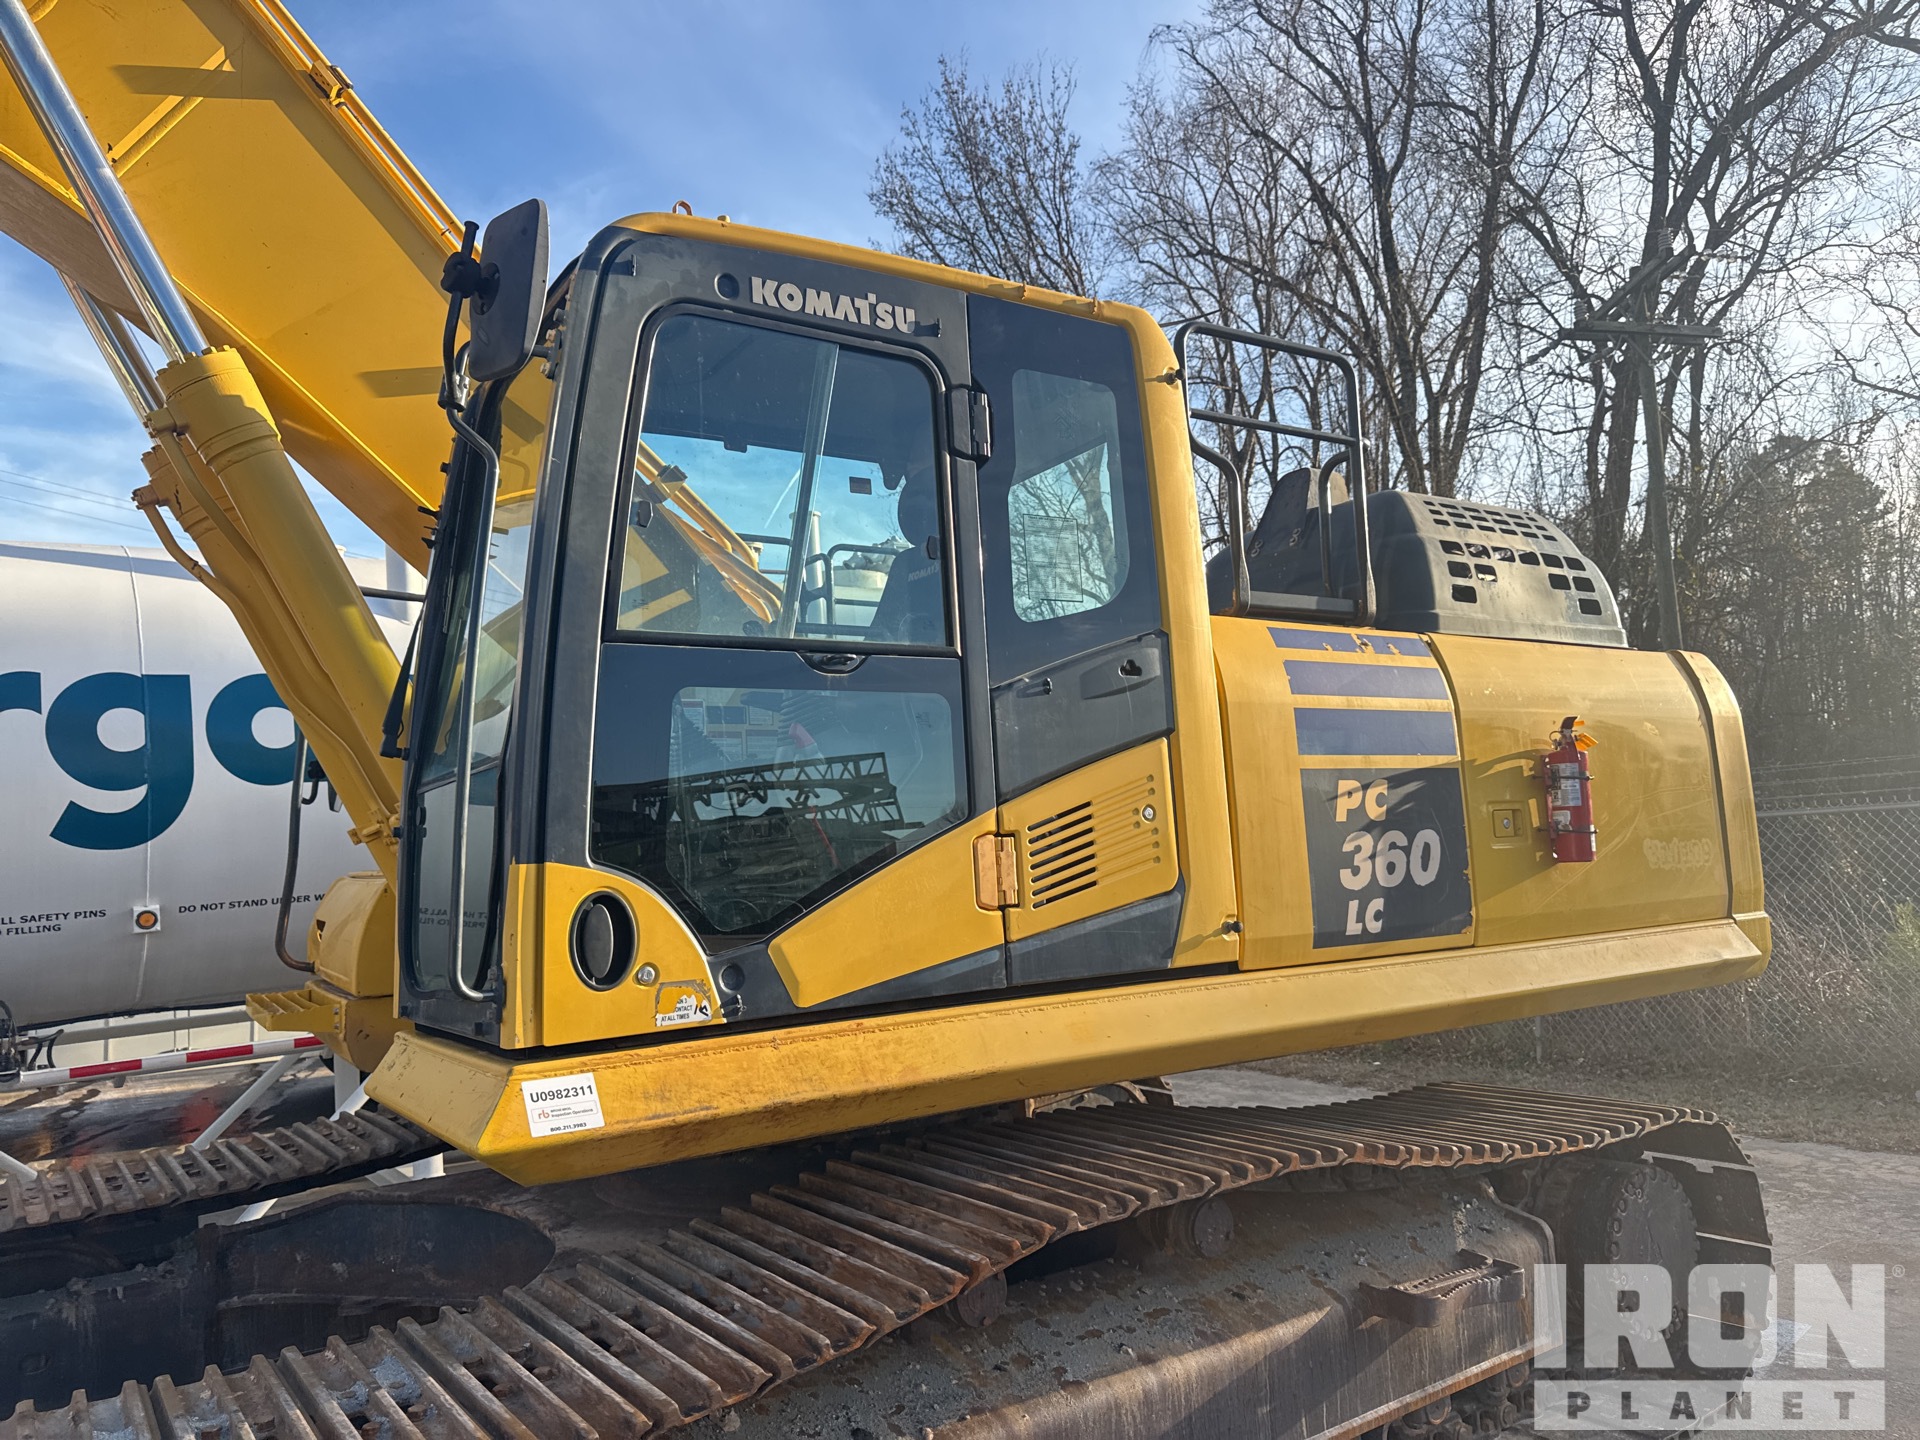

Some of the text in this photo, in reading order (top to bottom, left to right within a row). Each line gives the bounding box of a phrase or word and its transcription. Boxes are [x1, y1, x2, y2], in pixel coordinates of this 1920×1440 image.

[751, 276, 916, 334] KOMATSU
[908, 561, 941, 582] KOMATS
[1335, 778, 1389, 822] PC
[1339, 828, 1441, 891] 360
[178, 905, 197, 914] DO
[200, 902, 226, 912] NOT
[228, 898, 268, 909] STAND
[271, 894, 311, 906] UDER
[0, 909, 107, 925] LL SAFETY PINS
[1345, 897, 1385, 936] LC
[6, 924, 62, 935] FILLING
[529, 1084, 594, 1103] U0982311
